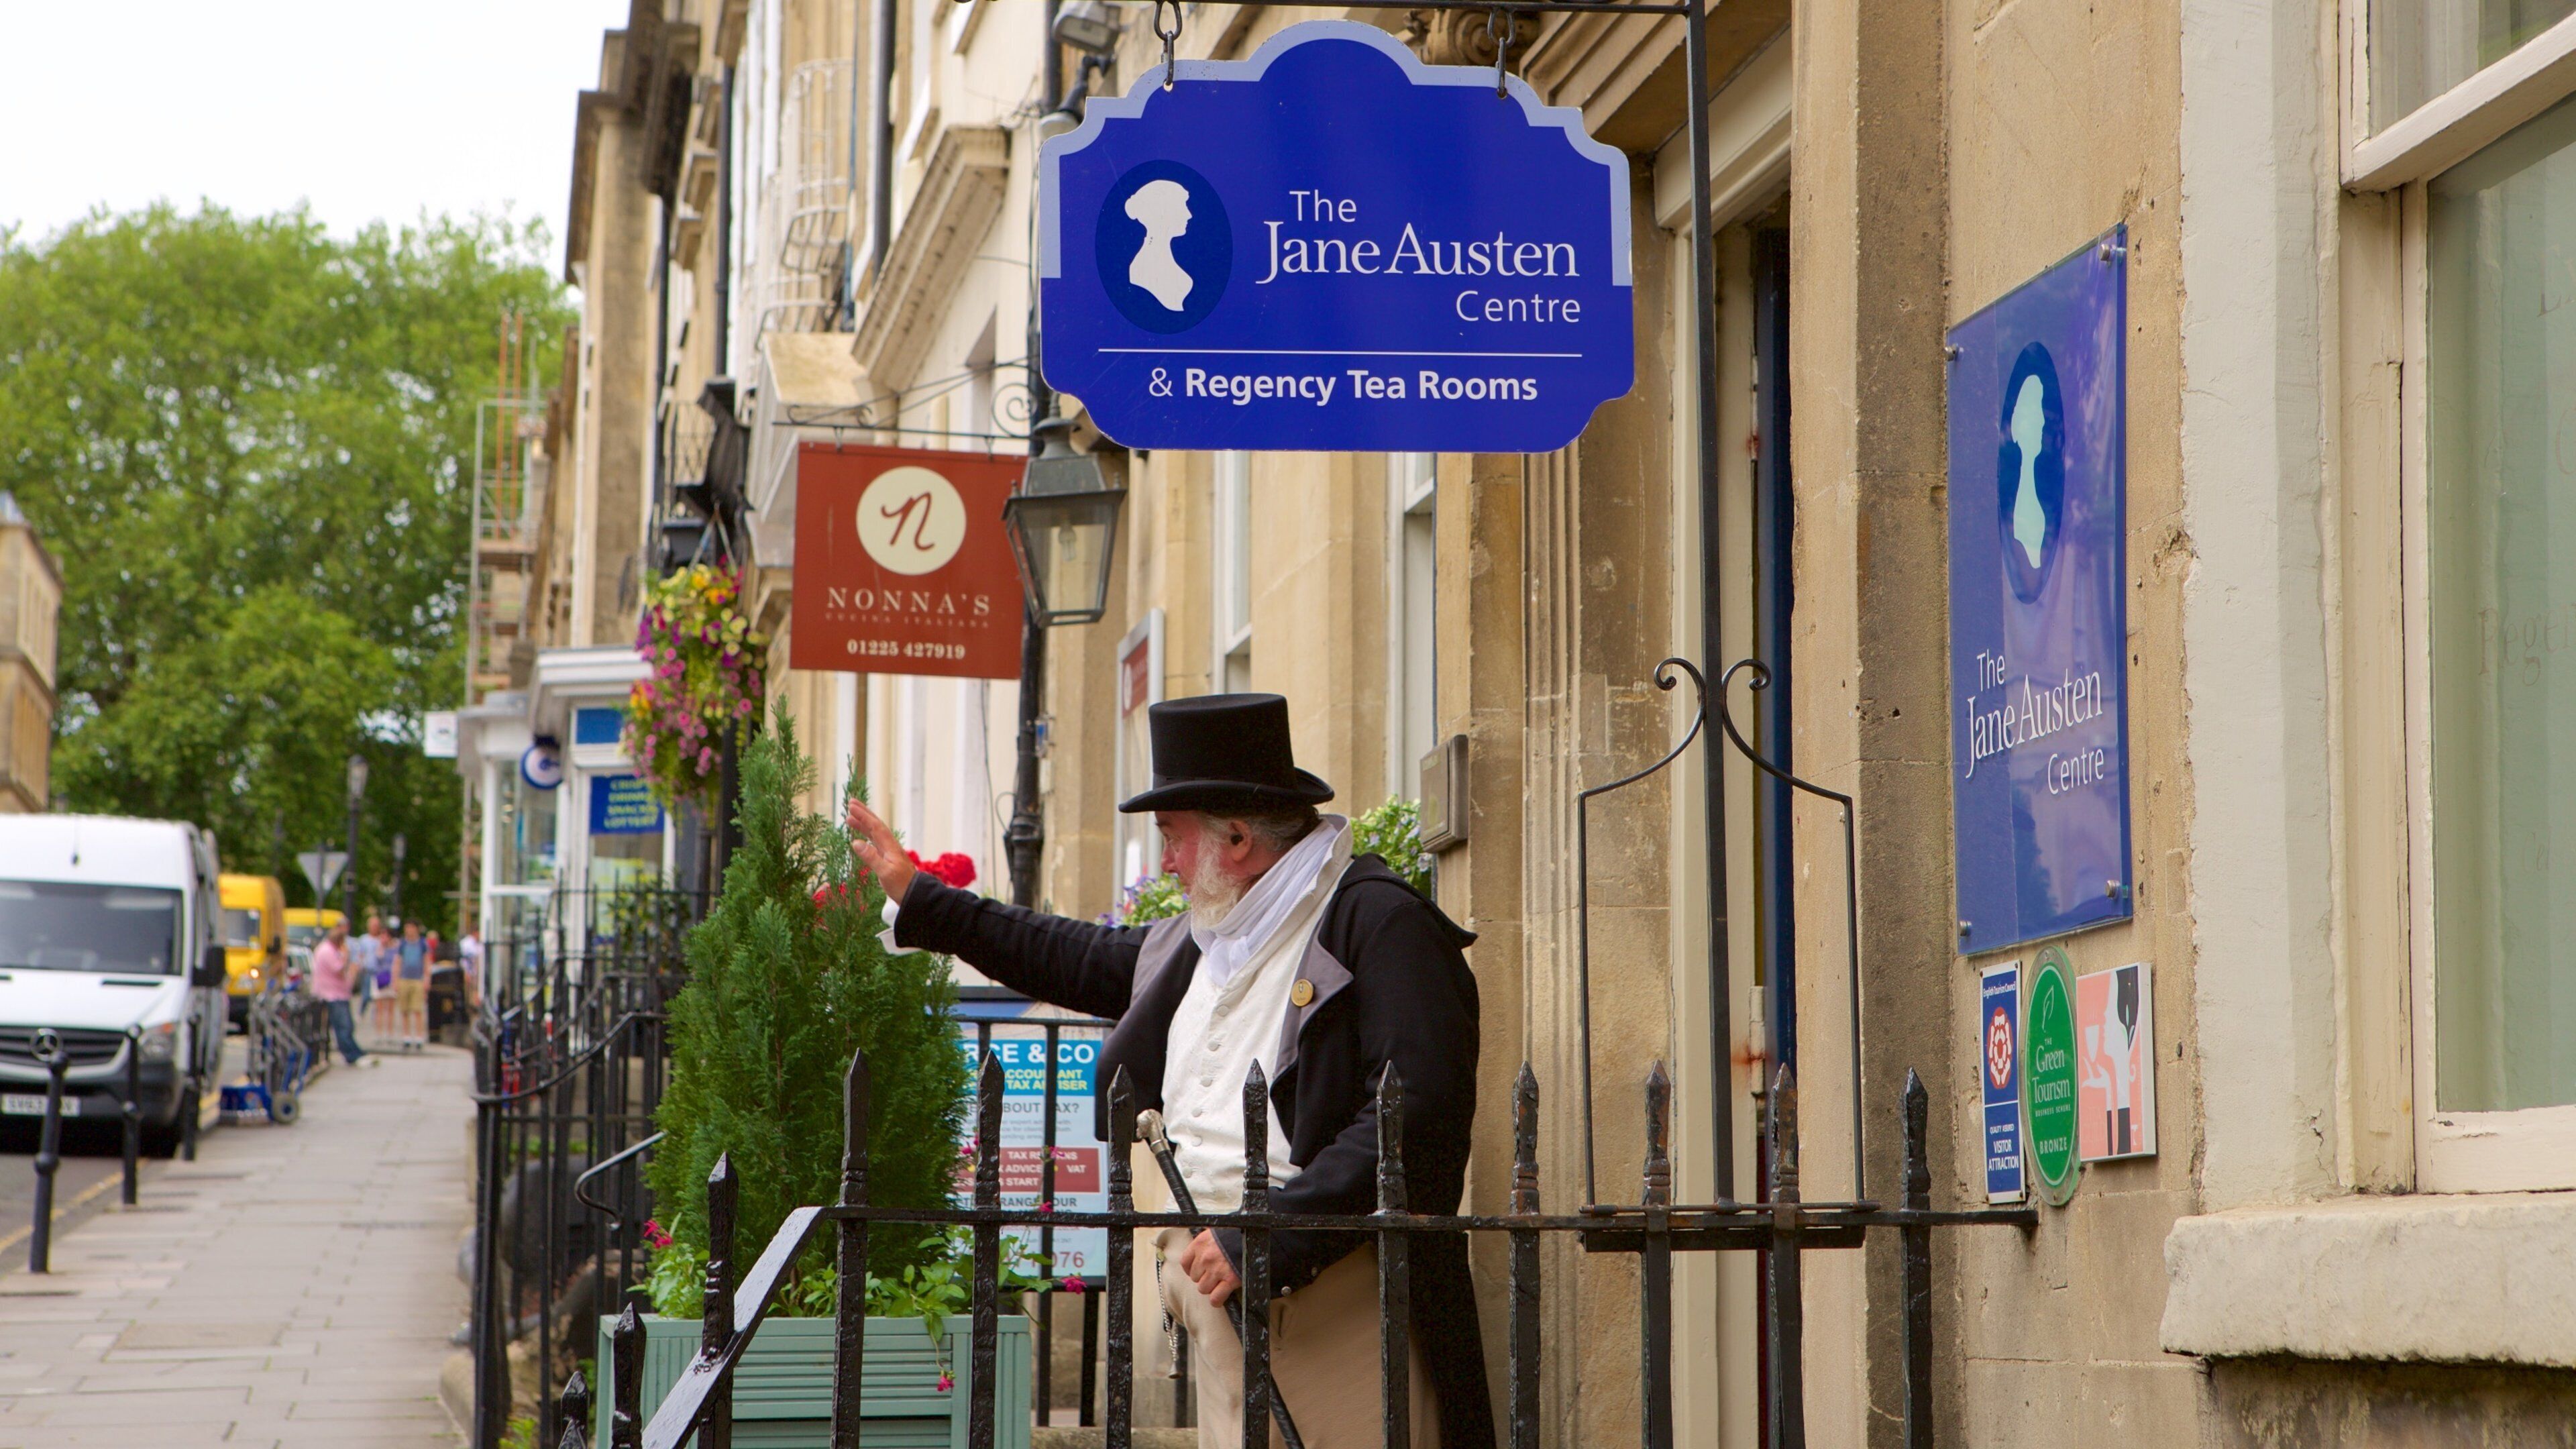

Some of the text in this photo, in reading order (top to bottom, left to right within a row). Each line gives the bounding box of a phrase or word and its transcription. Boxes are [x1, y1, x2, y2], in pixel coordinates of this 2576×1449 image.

[1289, 190, 1356, 222] The
[1256, 220, 1580, 284] Jane Austen
[1456, 290, 1580, 323] Centre
[1148, 368, 1538, 407] & Regency Tea Rooms
[826, 586, 990, 616] NONNA'S
[847, 638, 966, 660] 01225 427919
[1976, 649, 2006, 692] The
[1965, 667, 2103, 779] Jane Austen
[2047, 746, 2105, 796] Centre
[1057, 1043, 1095, 1064] CO
[2044, 1038, 2053, 1046] THE
[2036, 1045, 2065, 1073] Green
[1007, 1080, 1030, 1090] TAX
[2031, 1076, 2072, 1104] Tourism
[1003, 1102, 1080, 1114] BOUT AX?
[1008, 1150, 1027, 1160] TAX
[1993, 1139, 2012, 1154] VISITOR
[2039, 1136, 2068, 1155] BRONZE
[1006, 1164, 1044, 1174] ADVICE
[1066, 1164, 1087, 1174] VAT
[1988, 1155, 2019, 1172] ATTRACTION
